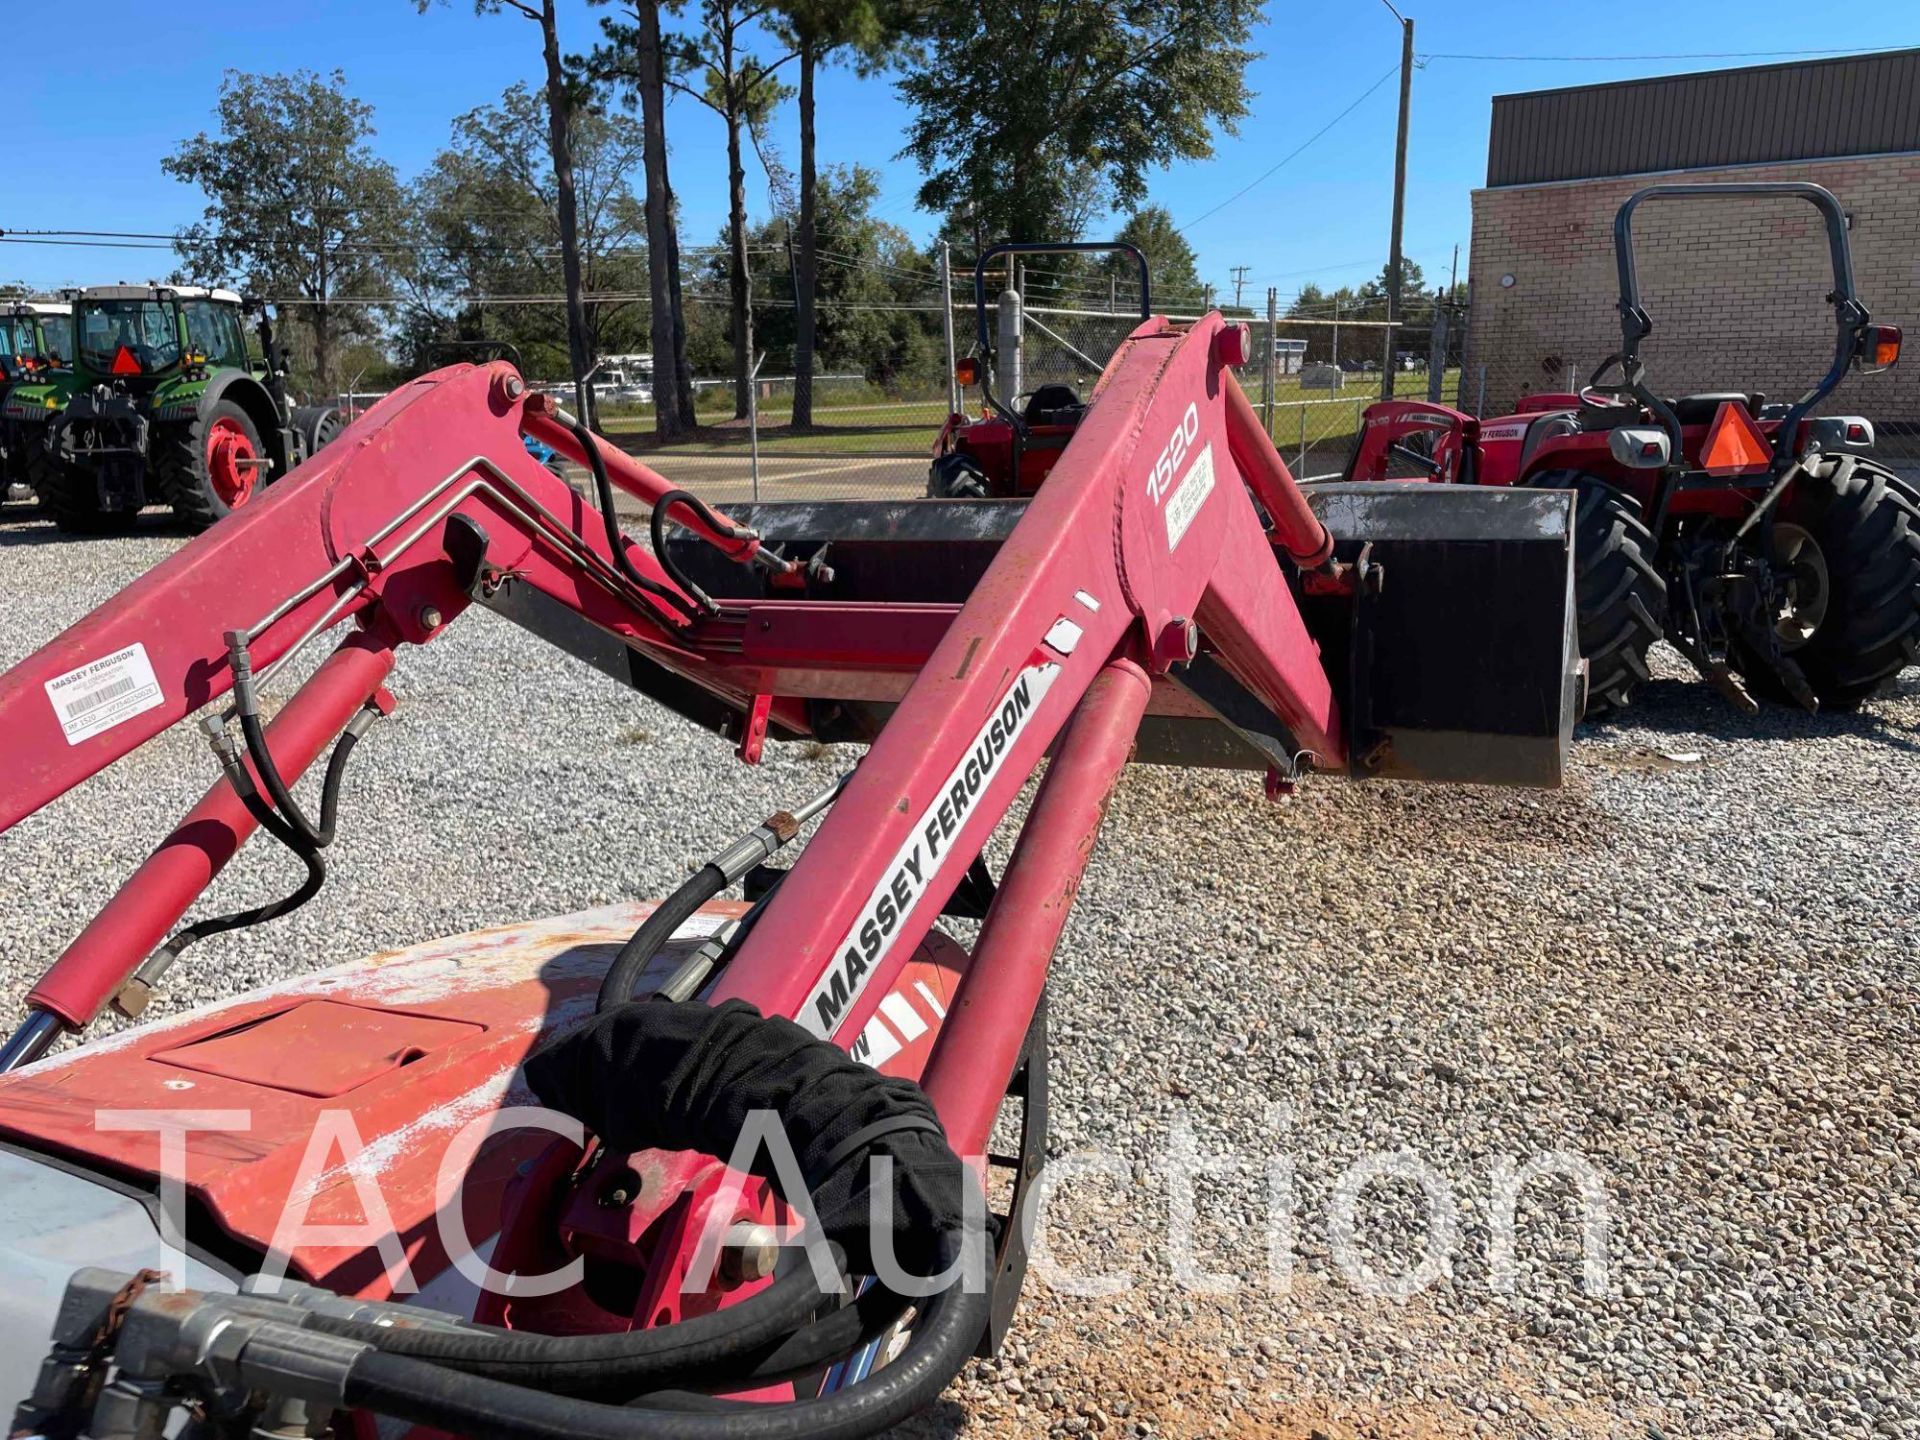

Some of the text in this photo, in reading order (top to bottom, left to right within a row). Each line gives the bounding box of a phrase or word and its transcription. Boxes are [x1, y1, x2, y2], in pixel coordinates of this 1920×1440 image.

[1147, 402, 1199, 506] 1520
[51, 670, 88, 691] MASSEY
[89, 650, 135, 674] FERGUSON
[80, 713, 97, 726] 1520
[814, 676, 1031, 1031] MASSEY FERGUSON
